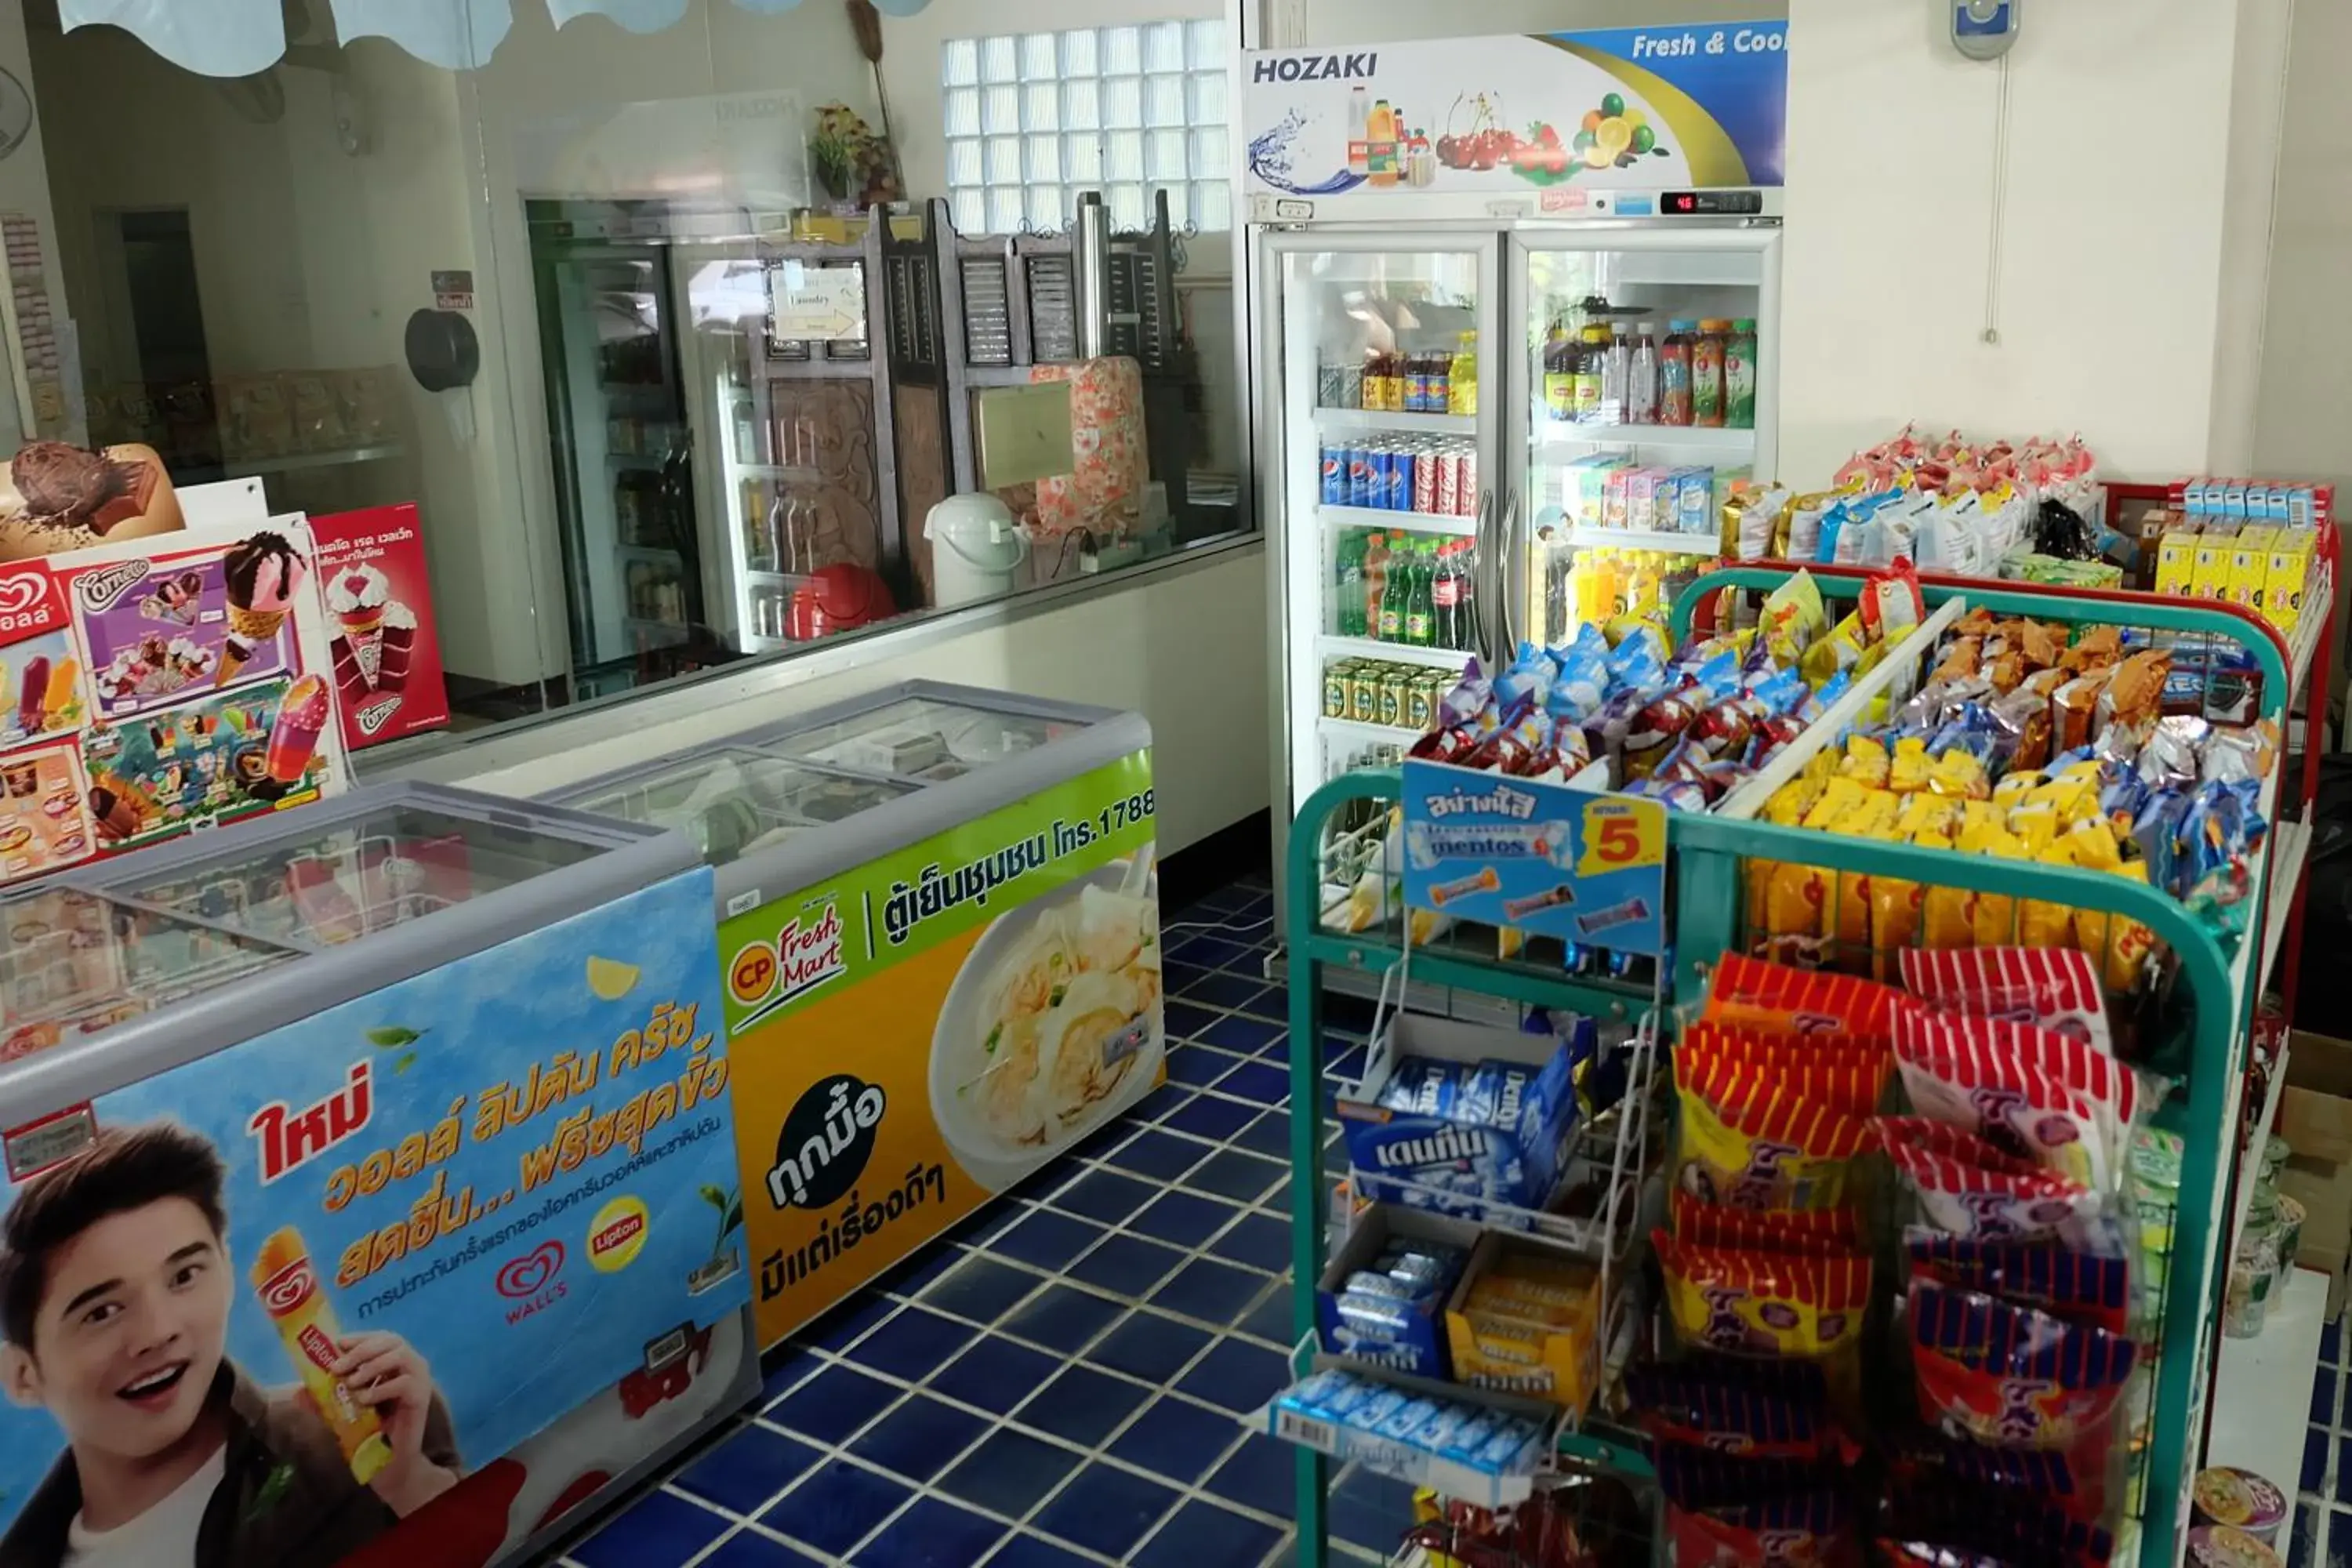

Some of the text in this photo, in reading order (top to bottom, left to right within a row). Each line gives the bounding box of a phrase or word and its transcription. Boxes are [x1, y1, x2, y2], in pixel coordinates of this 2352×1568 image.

[1254, 52, 1377, 84] HOZAKI
[1632, 33, 1696, 58] Fresh
[1705, 31, 1725, 54] &
[74, 557, 151, 614] Cornetto
[0, 603, 50, 631] อลล์
[1431, 837, 1526, 858] mentos
[1596, 818, 1640, 862] 5
[884, 832, 1046, 945] ตู้เย็นชุมชน
[780, 906, 840, 962] Fresh
[736, 956, 771, 989] CP
[784, 941, 840, 989] Mart
[249, 1062, 373, 1182] ใหม่
[324, 1095, 467, 1213] วอลล์
[472, 1050, 600, 1142] ลิปตัน
[765, 1082, 886, 1213] ทุกมื้อ
[595, 1216, 641, 1251] Lipton
[759, 1162, 946, 1301] มีแต่เรื่องดีๆ
[505, 1280, 568, 1326] WALL'S
